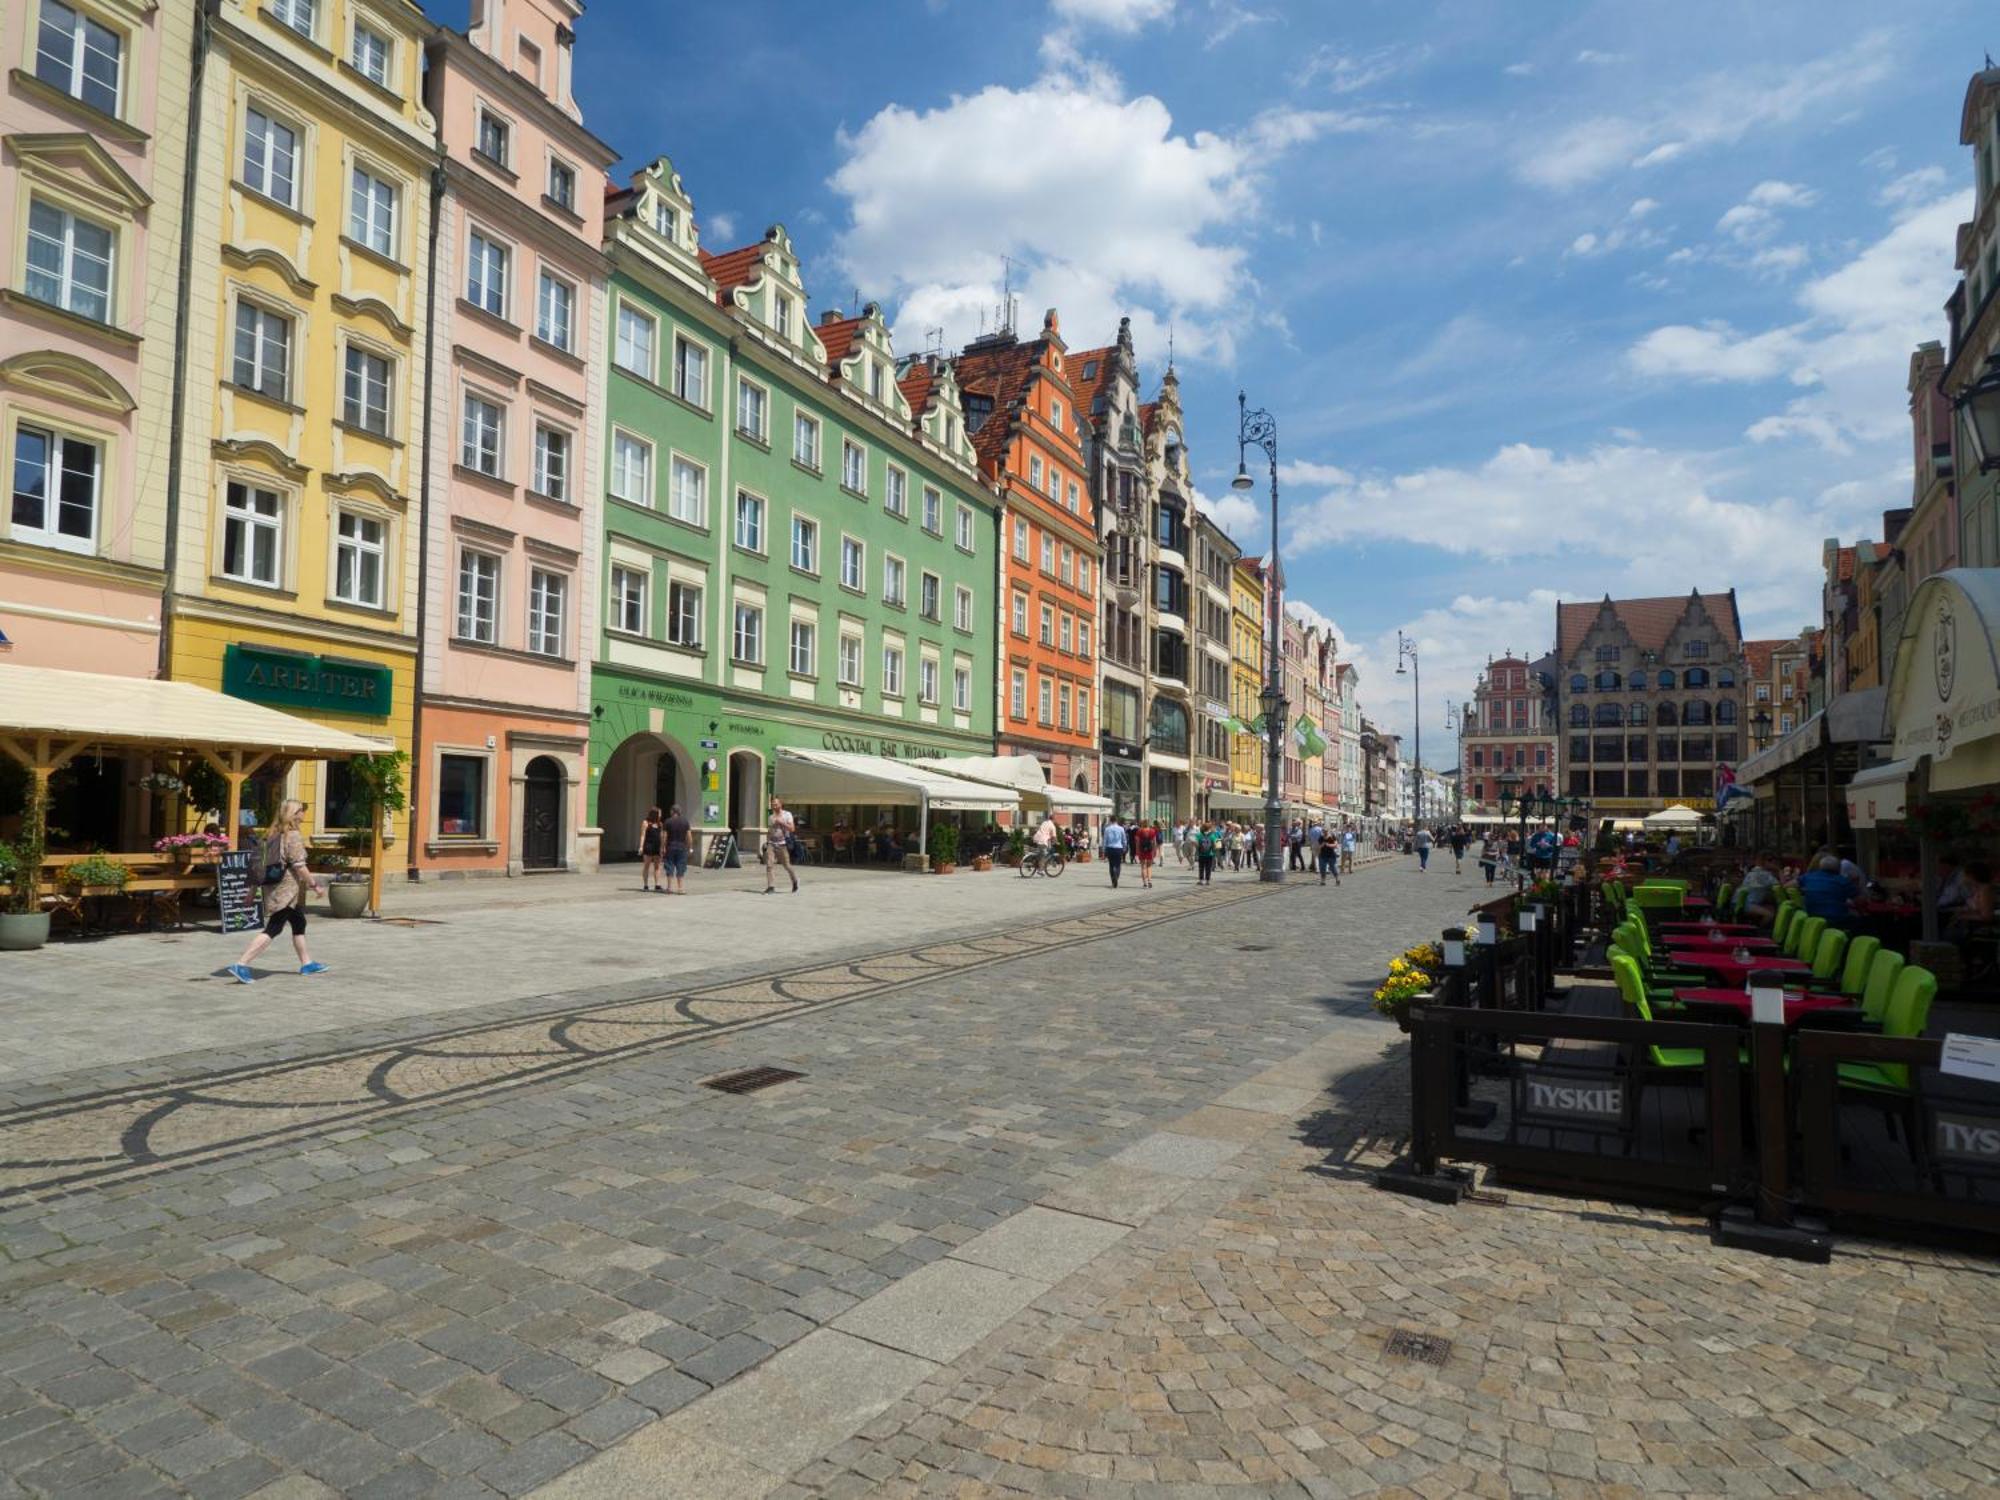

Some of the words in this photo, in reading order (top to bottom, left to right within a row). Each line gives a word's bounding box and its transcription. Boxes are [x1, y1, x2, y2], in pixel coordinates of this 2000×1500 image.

[246, 662, 376, 698] ARBITER
[822, 732, 874, 756] COCKTAIL
[880, 740, 897, 757] BAR
[1528, 1082, 1622, 1113] TYSKIE
